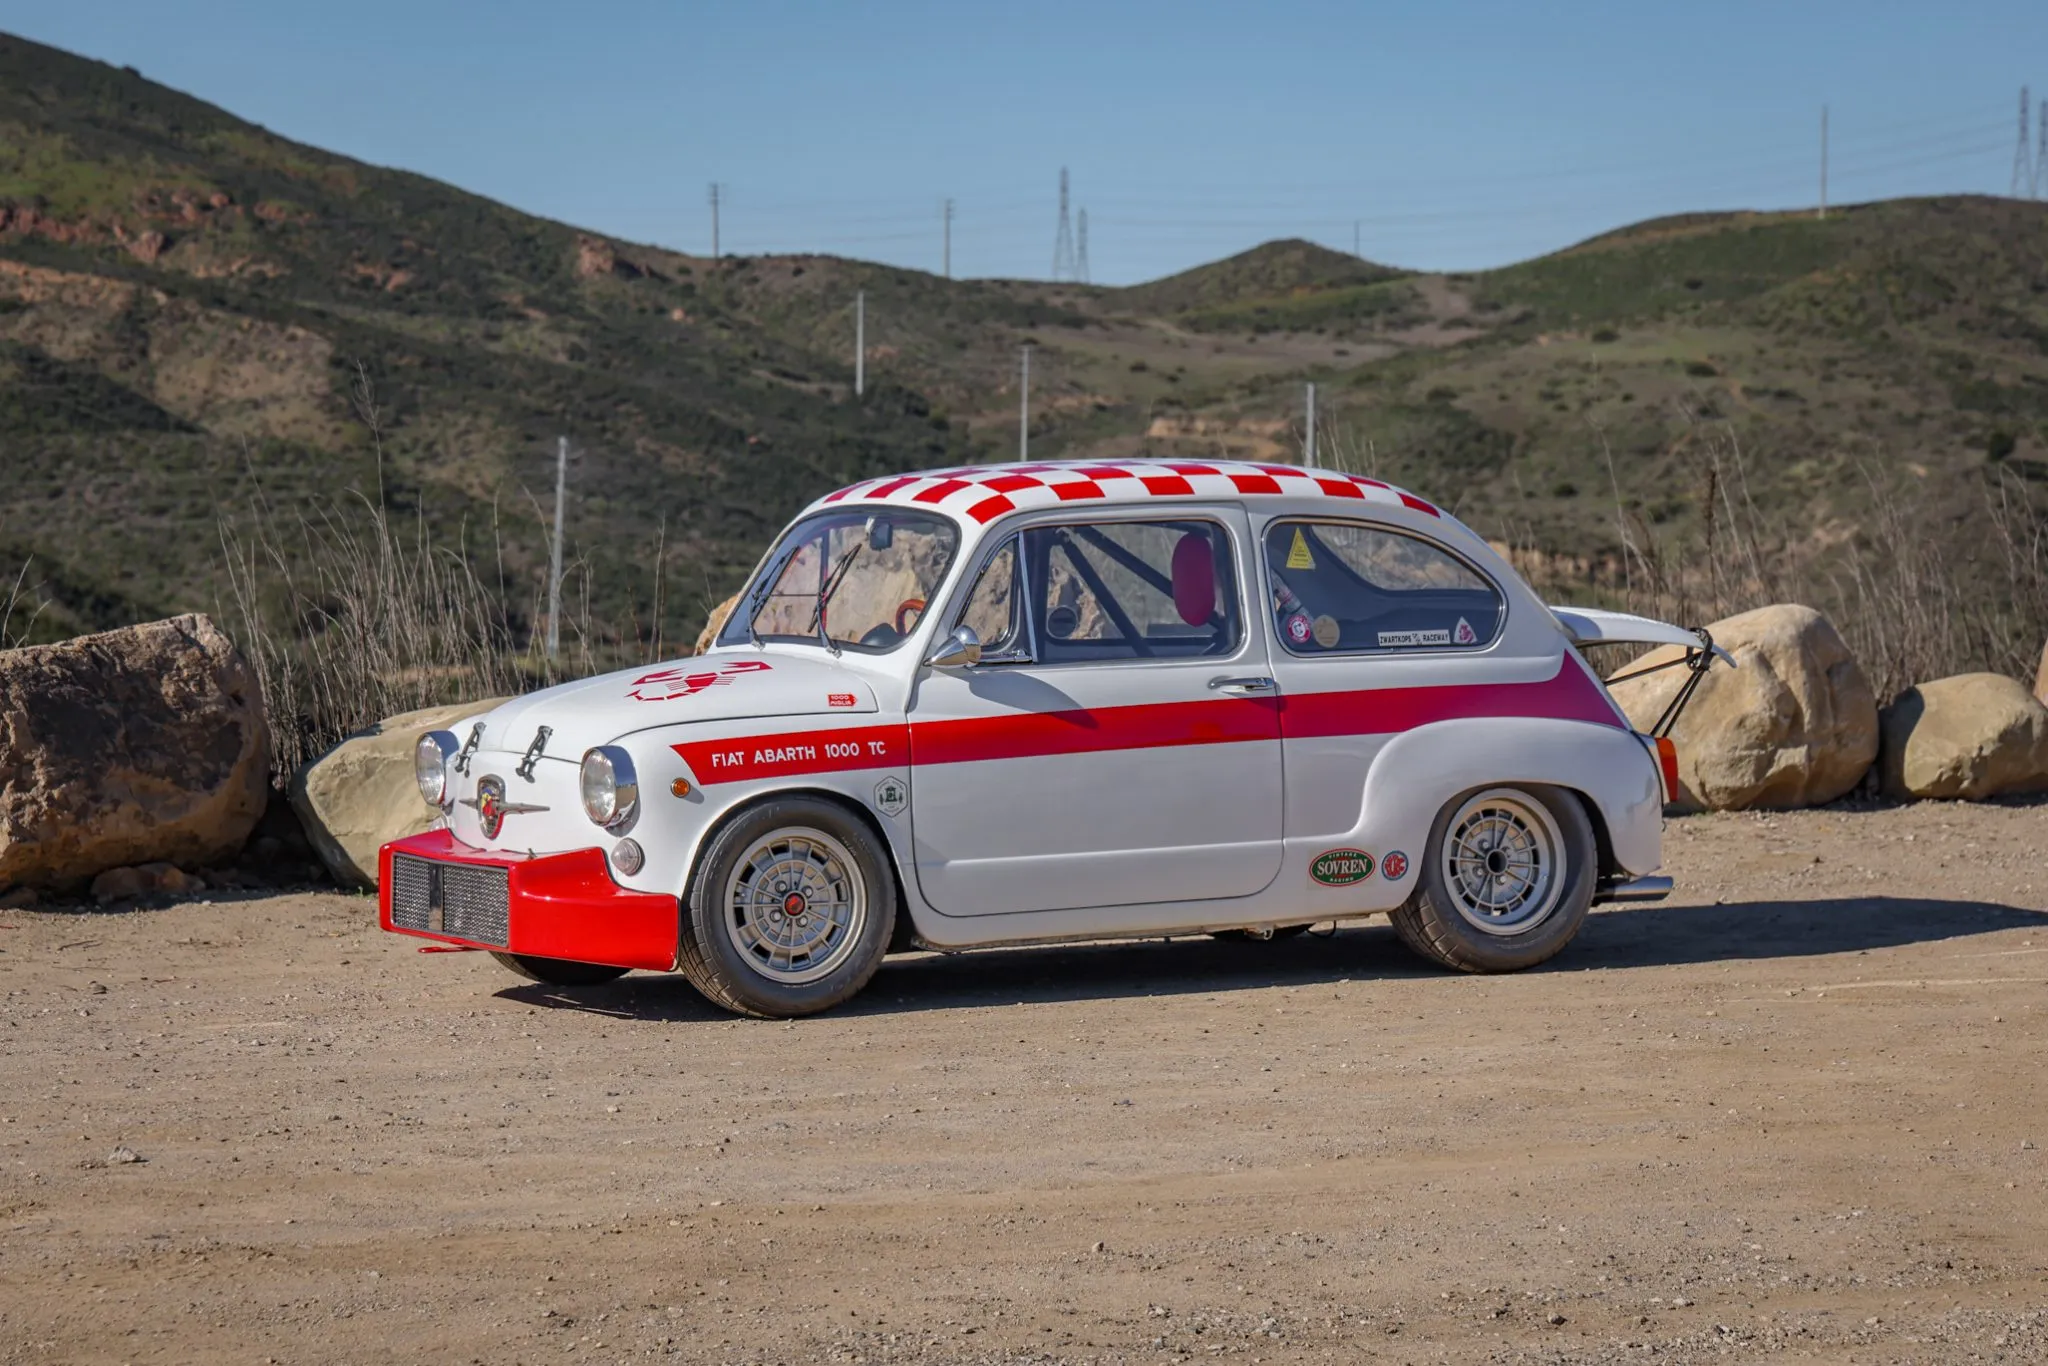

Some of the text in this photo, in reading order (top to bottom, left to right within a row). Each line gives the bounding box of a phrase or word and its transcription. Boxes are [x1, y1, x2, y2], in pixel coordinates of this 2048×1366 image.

[1380, 635, 1411, 644] ZWARTKOPS
[1423, 632, 1449, 642] RACEWAY
[712, 741, 886, 767] FIAT ABARTH 1000 TC
[1317, 859, 1367, 875] SOVREN
